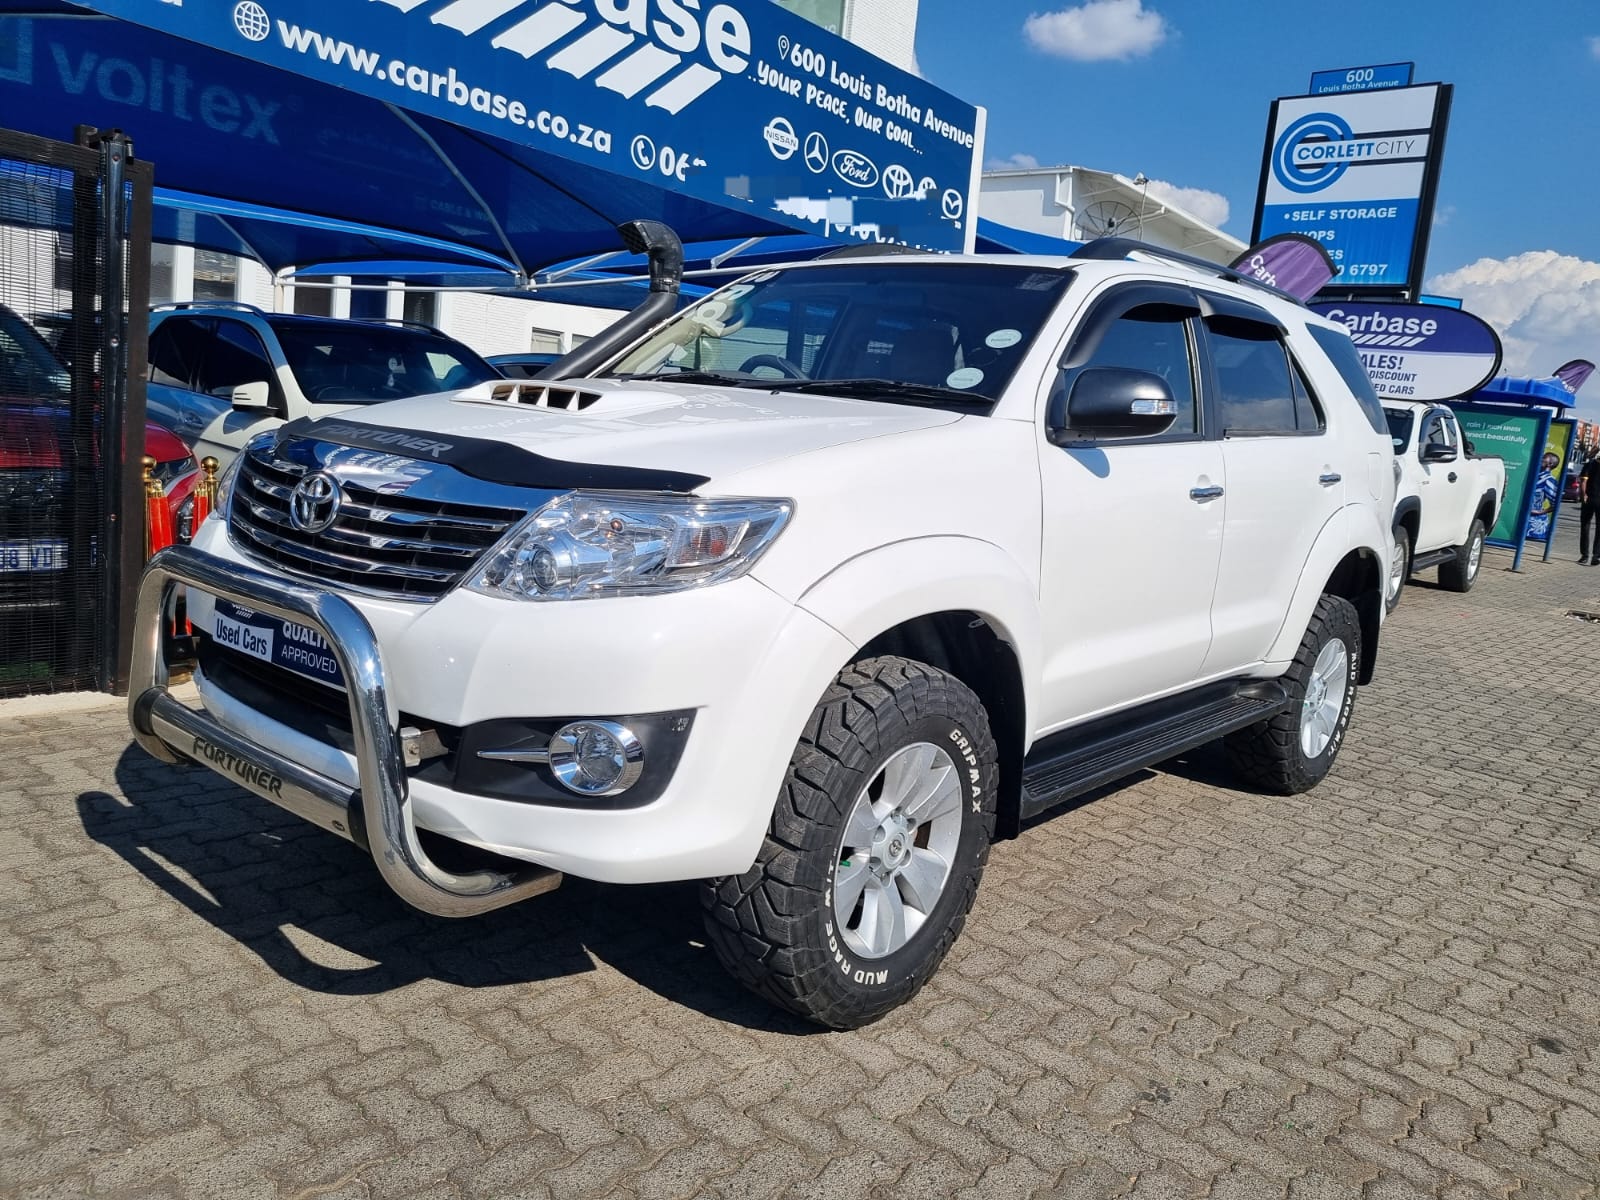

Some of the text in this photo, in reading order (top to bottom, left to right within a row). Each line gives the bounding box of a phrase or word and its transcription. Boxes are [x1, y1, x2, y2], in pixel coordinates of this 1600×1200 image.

[560, 0, 750, 74] ase
[277, 19, 612, 154] www.carbase.co.za
[1318, 79, 1399, 94] Louis Botha Avenue
[1346, 68, 1374, 83] 600
[50, 42, 280, 146] voltex
[790, 43, 974, 149] 600 Louis Botha Avenue
[806, 83, 850, 125] PEACE,
[854, 106, 883, 135] OUR
[766, 129, 797, 148] NISSAN
[660, 146, 708, 182] 06
[840, 154, 871, 182] Ford
[1291, 207, 1397, 222] SELF STORAGE
[1251, 254, 1276, 288] Carb
[1349, 263, 1388, 276] 6797
[1325, 309, 1438, 335] Carbase
[1360, 353, 1405, 371] ALES!
[1368, 369, 1418, 383] DISCOUNT
[1372, 383, 1416, 396] ED CARS
[307, 424, 454, 458] FORTUNER
[216, 618, 268, 656] Used Cars
[281, 644, 337, 674] APPROVED
[1350, 652, 1358, 681] MUD
[1341, 685, 1355, 728] RAGE
[192, 735, 283, 799] FORTUNER
[949, 728, 982, 814] GRIPMAX
[825, 919, 852, 976] RAGE
[854, 969, 888, 985] MUD
